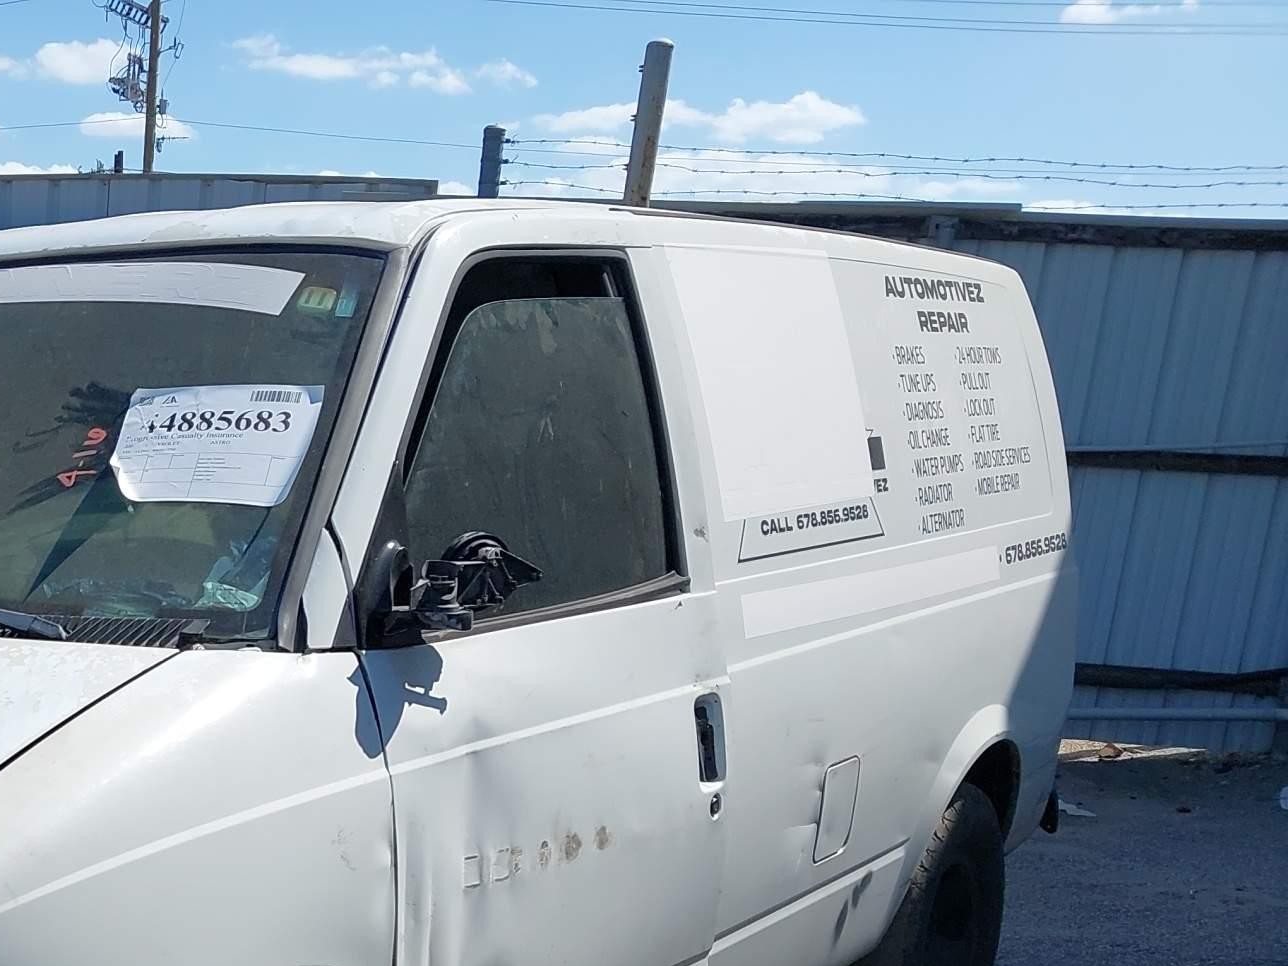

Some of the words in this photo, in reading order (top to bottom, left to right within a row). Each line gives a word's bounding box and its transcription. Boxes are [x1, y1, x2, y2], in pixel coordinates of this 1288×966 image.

[884, 275, 985, 303] AUTOMOTIVEZ
[916, 310, 970, 333] REPAIR
[895, 346, 925, 364] BRAKES
[899, 374, 921, 392] TUNE
[921, 373, 936, 392] UPS
[961, 373, 978, 390] PULL
[978, 373, 991, 390] OUT
[906, 400, 944, 421] DIAGNOSIS
[966, 399, 982, 416] LOCK
[982, 398, 995, 415] OUT
[909, 430, 922, 449] OIL
[922, 428, 951, 448] CHANGE
[970, 424, 986, 443] FLAT
[985, 424, 1000, 441] TIRE
[914, 456, 940, 478] WATER
[940, 454, 964, 475] PUMPS
[974, 451, 992, 469] ROAD
[992, 449, 1005, 467] SIDE
[1005, 446, 1031, 465] SERVICES
[918, 483, 953, 505] RADIATOR
[977, 476, 1000, 496] MOBILE
[1000, 472, 1020, 491] REPAIR
[760, 516, 793, 536] CALL
[797, 504, 869, 529] 678.856.9528
[922, 508, 965, 534] ALTERNATOR
[1005, 532, 1067, 564] 678.856.9528
